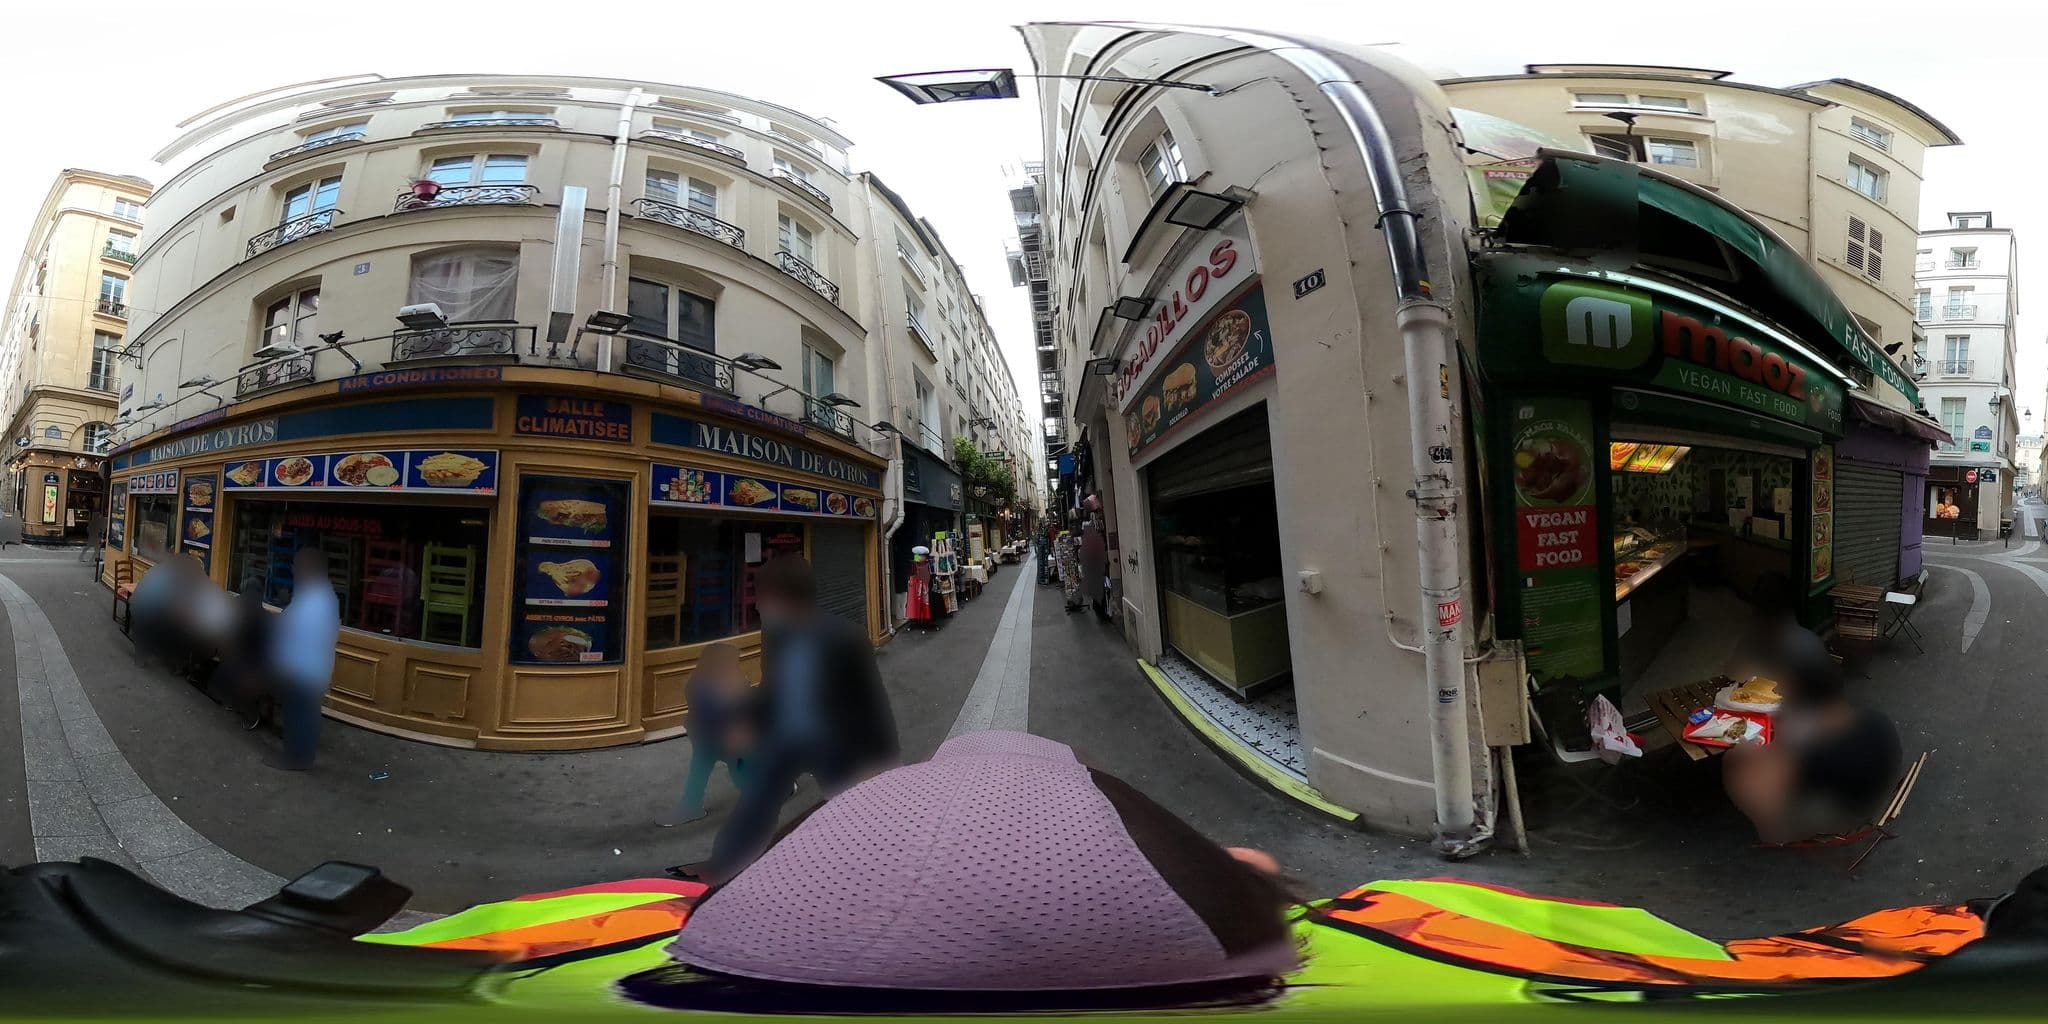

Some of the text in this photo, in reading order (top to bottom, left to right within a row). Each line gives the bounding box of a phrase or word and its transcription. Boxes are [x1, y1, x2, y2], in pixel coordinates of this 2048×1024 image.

[1300, 275, 1319, 292] 10
[1117, 239, 1237, 401] BOCADILLOS
[1214, 351, 1249, 386] COMPOSEZ
[1662, 309, 1807, 399] maoz
[1845, 323, 1905, 393] FAST FOOD
[342, 367, 498, 389] AIR CONDITIONED
[1211, 356, 1260, 400] VOTRE SALADE
[1679, 368, 1798, 417] VEGAN FAST FOOD
[544, 399, 604, 417] SALLE
[748, 408, 806, 434] CLIMATISEE
[151, 441, 190, 461] MAISON
[191, 436, 209, 454] DE
[214, 420, 275, 448] GYROS
[518, 416, 629, 439] CLIMATISEE
[697, 423, 868, 486] MAISON DE GYROS
[1526, 511, 1587, 528] VEGAN
[1537, 531, 1579, 547] FAST
[1536, 549, 1582, 566] FOOD
